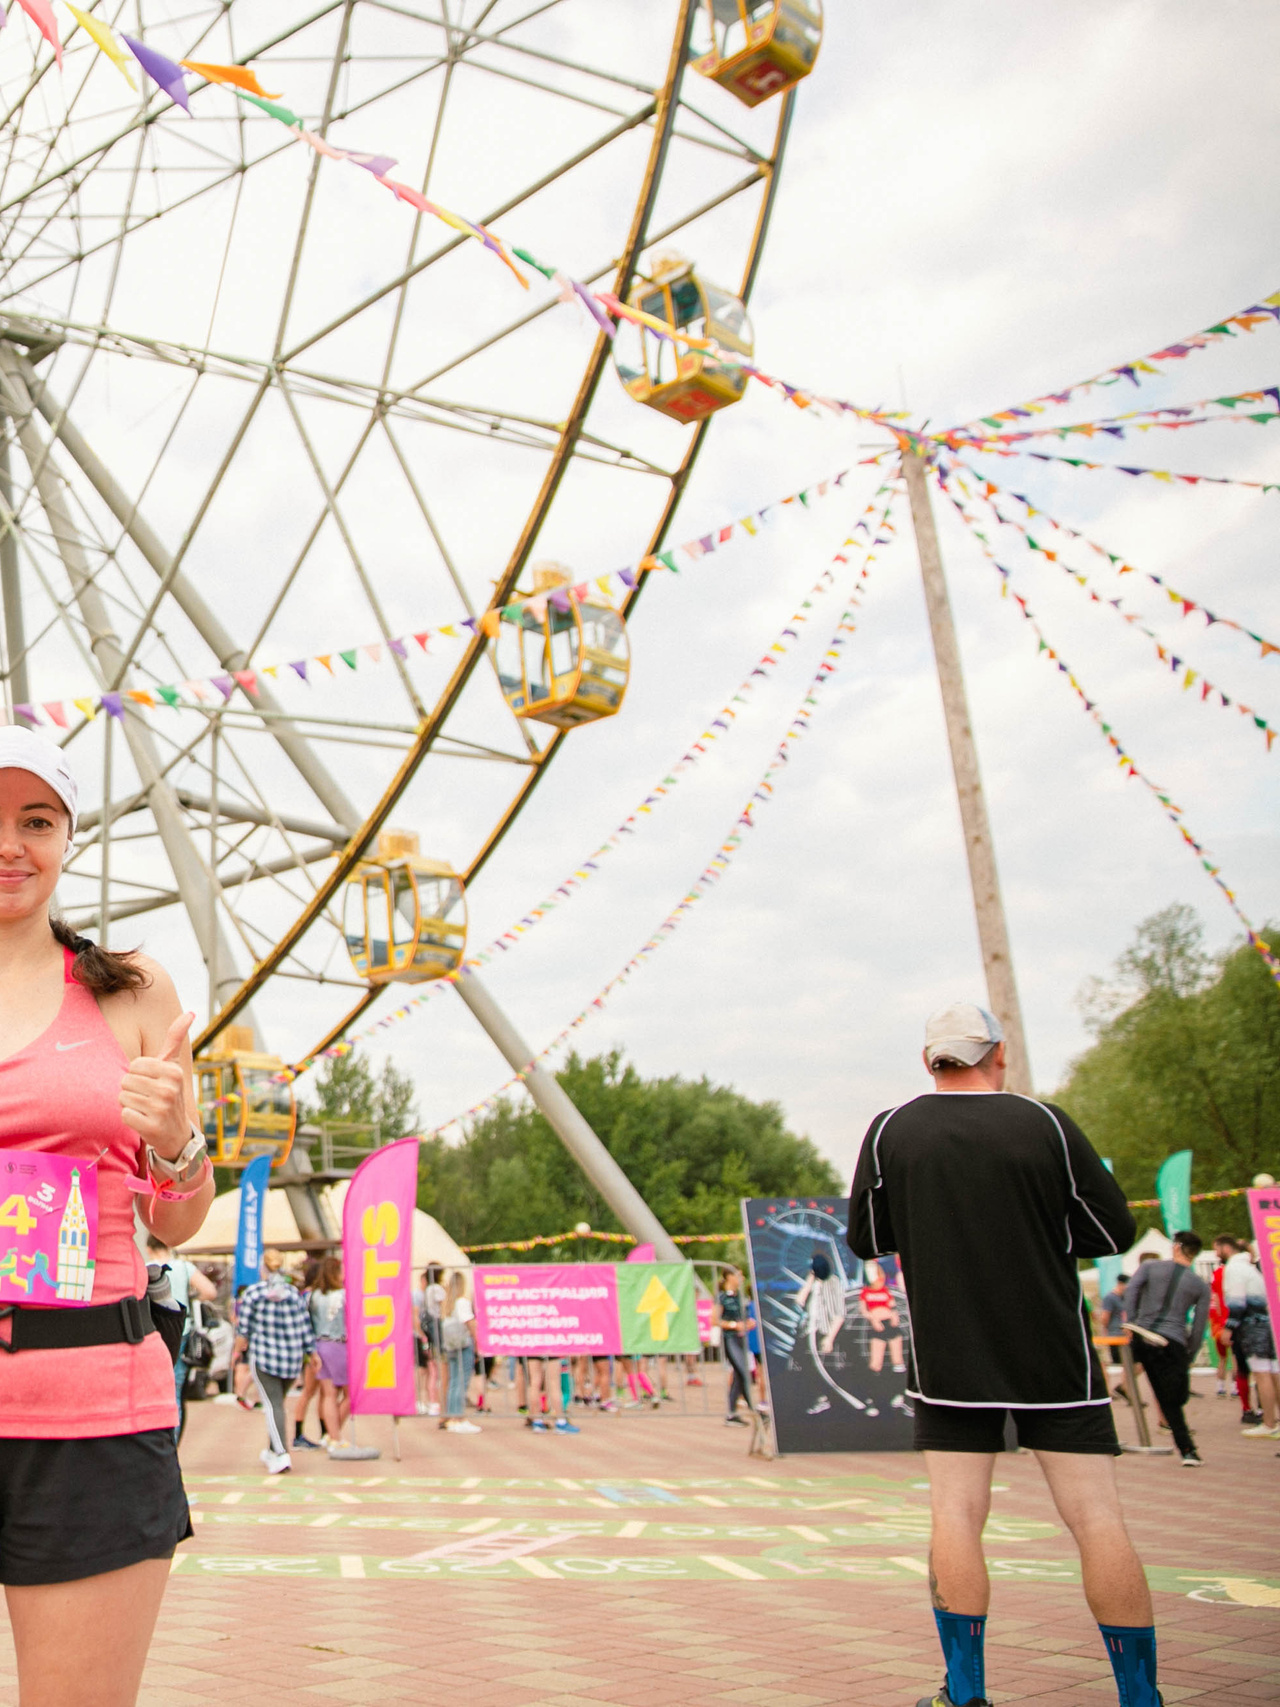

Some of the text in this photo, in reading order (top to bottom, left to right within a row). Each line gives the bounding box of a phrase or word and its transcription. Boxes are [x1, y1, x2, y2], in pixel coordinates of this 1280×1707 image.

[36, 1182, 56, 1202] 3
[244, 1181, 258, 1269] GEELY
[362, 1201, 401, 1389] RUTS
[485, 1287, 608, 1301] РЕГИСТРАЦИЯ
[486, 1305, 559, 1316] КАМЕРА
[489, 1317, 579, 1329] ХРАНЕНИЯ
[488, 1333, 604, 1347] РАЗДЕВАЛКИ
[553, 1558, 687, 1574] 30
